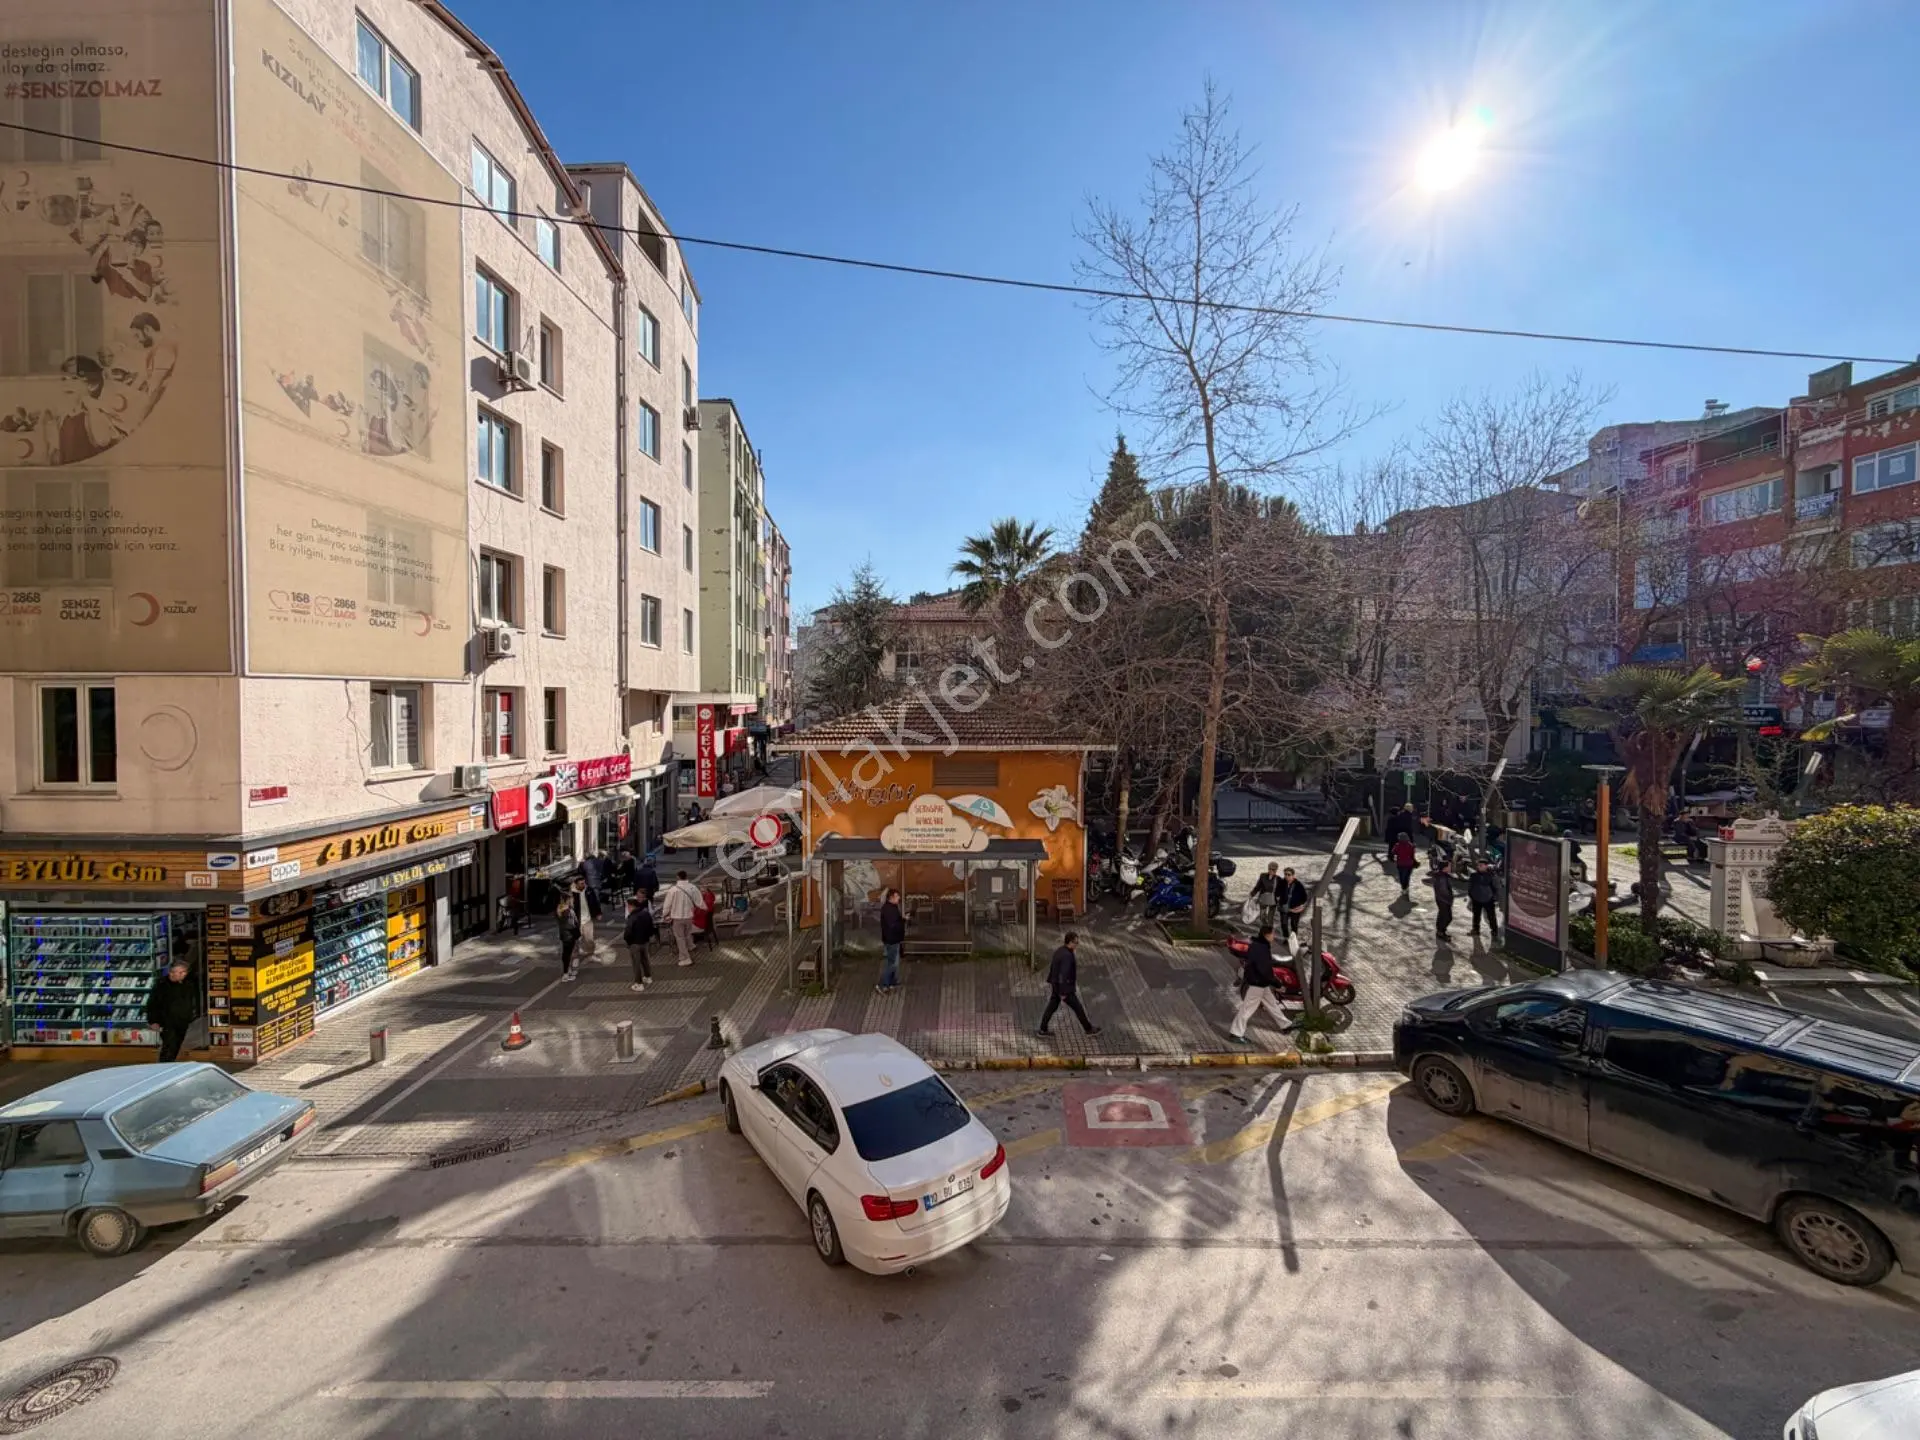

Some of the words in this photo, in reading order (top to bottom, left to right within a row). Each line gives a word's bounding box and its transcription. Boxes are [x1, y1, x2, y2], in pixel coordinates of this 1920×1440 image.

[70, 40, 129, 58] olmasa,
[34, 58, 55, 74] da
[60, 58, 112, 73] olmaz.
[261, 47, 327, 115] KIZILAY
[4, 79, 162, 99] #SENSİZOLMAZ
[101, 524, 168, 538] yanındayız.
[275, 523, 293, 537] her
[295, 531, 315, 543] gün
[124, 540, 145, 553] için
[268, 538, 286, 551] Biz
[11, 591, 42, 604] 2868
[61, 598, 101, 610] SENSİZ
[290, 591, 311, 605] 168
[333, 597, 357, 610] 2868
[59, 609, 101, 621] OLMAZ
[700, 723, 713, 793] ZEYBEK
[581, 769, 587, 781] 6
[326, 842, 338, 861] 6
[351, 825, 406, 857] EYLÜL
[413, 823, 445, 841] Gsm
[256, 853, 276, 863] Apple
[8, 854, 99, 882] EYLÜL
[105, 860, 165, 882] Gsm
[272, 862, 299, 880] oppo
